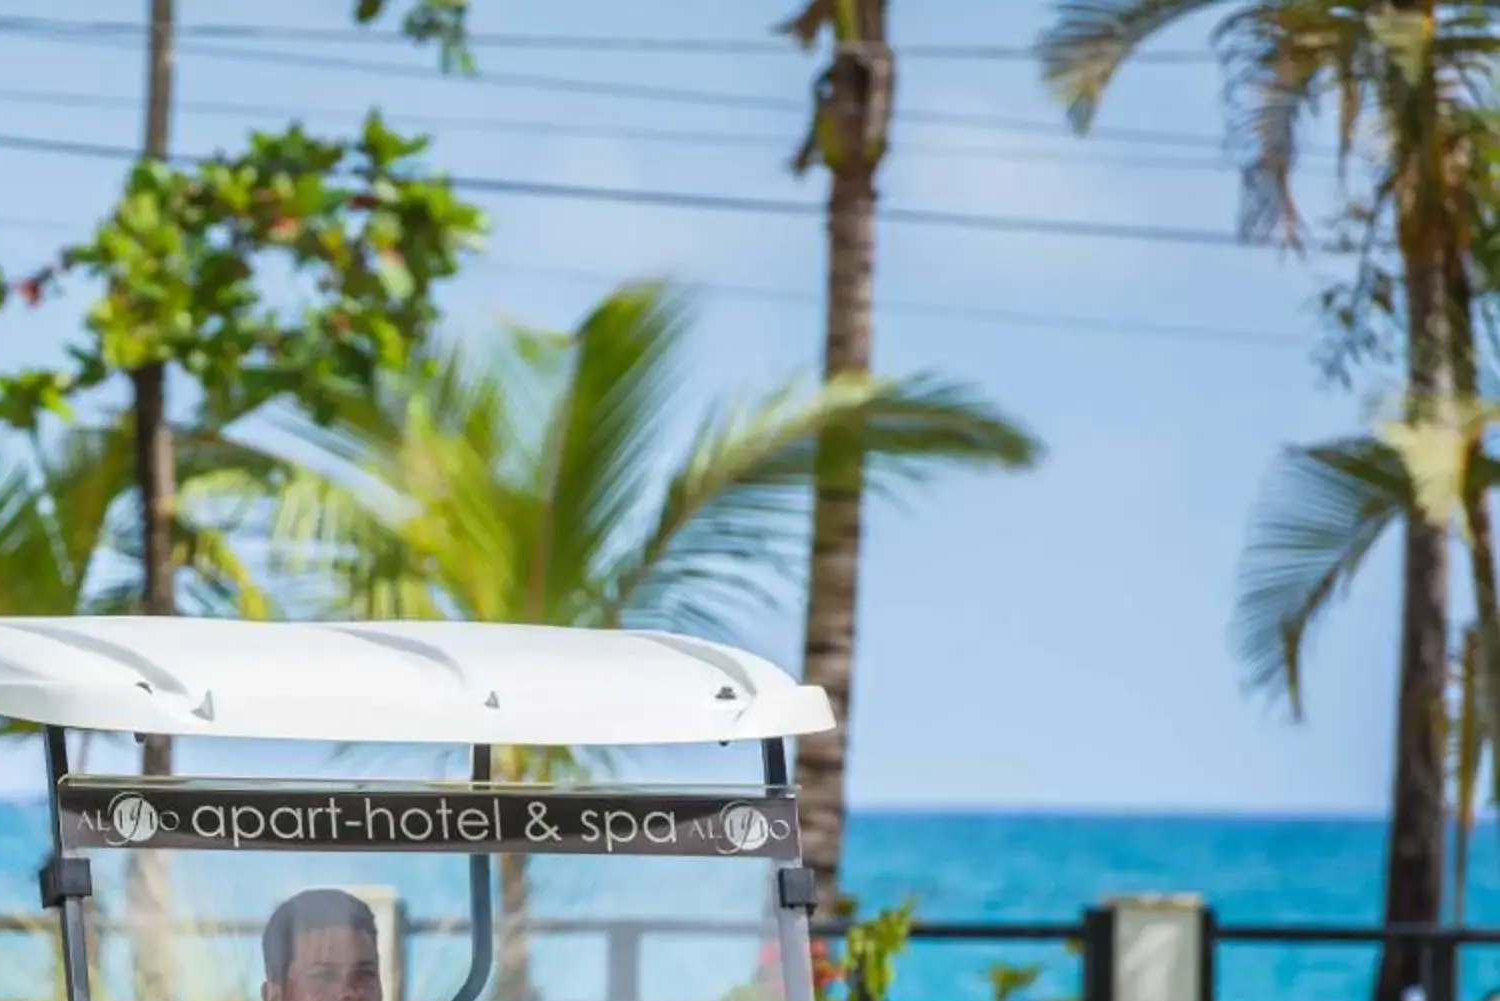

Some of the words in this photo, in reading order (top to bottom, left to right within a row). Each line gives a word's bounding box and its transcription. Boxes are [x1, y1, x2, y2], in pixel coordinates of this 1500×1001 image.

[191, 797, 501, 842] apart-hotel
[525, 802, 562, 843] &
[580, 809, 677, 852] spa
